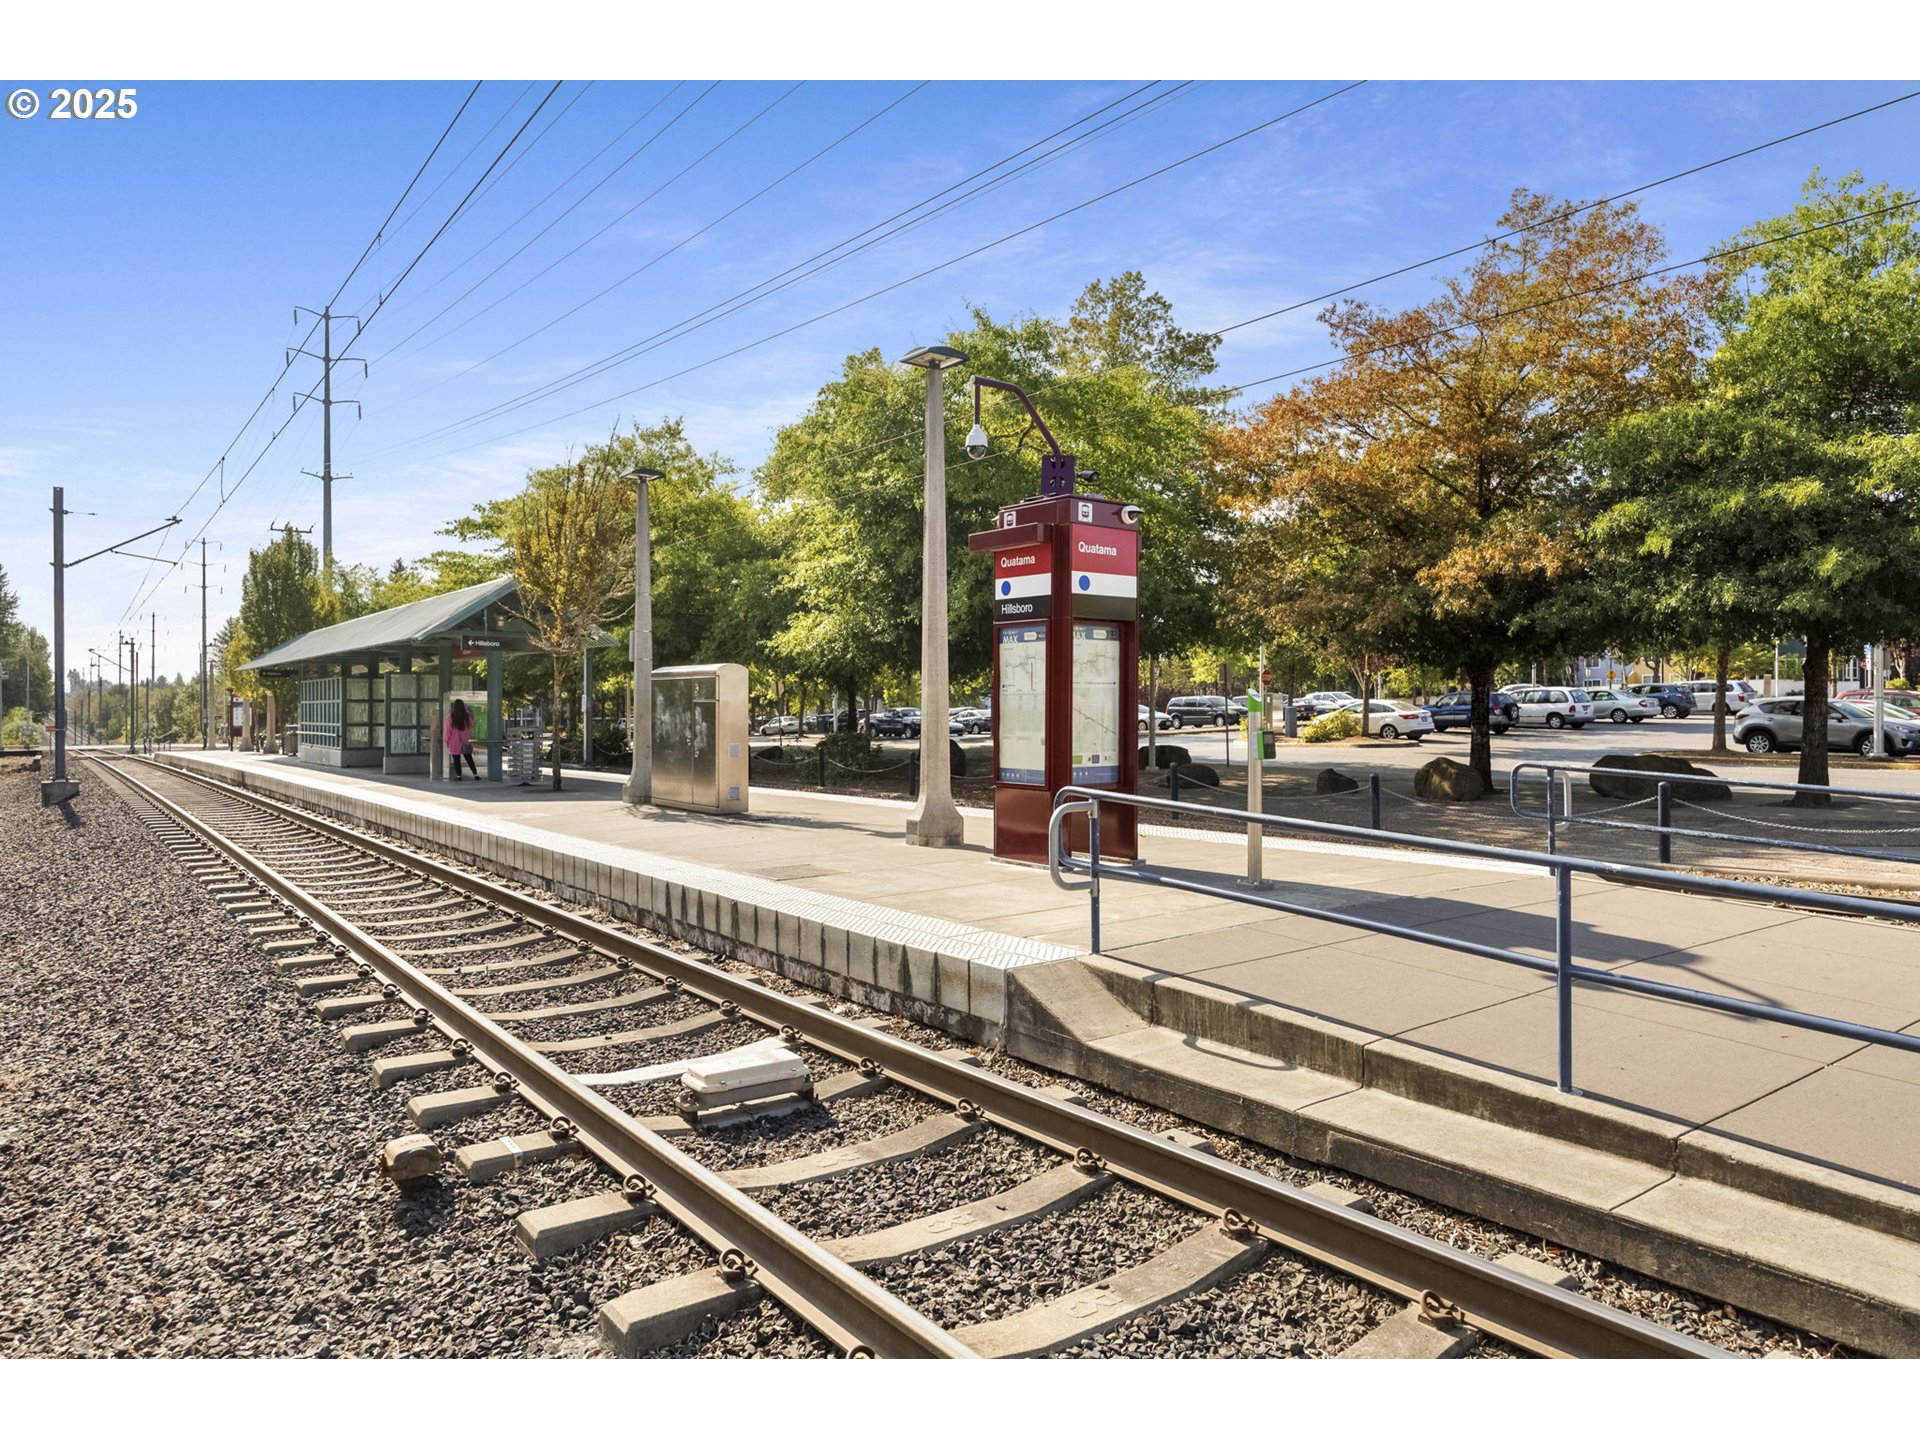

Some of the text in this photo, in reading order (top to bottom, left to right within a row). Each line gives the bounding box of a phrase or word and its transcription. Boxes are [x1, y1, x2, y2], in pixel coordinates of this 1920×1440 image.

[1078, 541, 1117, 556] Quatama
[1001, 555, 1035, 568] Quatama
[1001, 603, 1033, 615] Hillsboro
[1003, 635, 1018, 644] MAX
